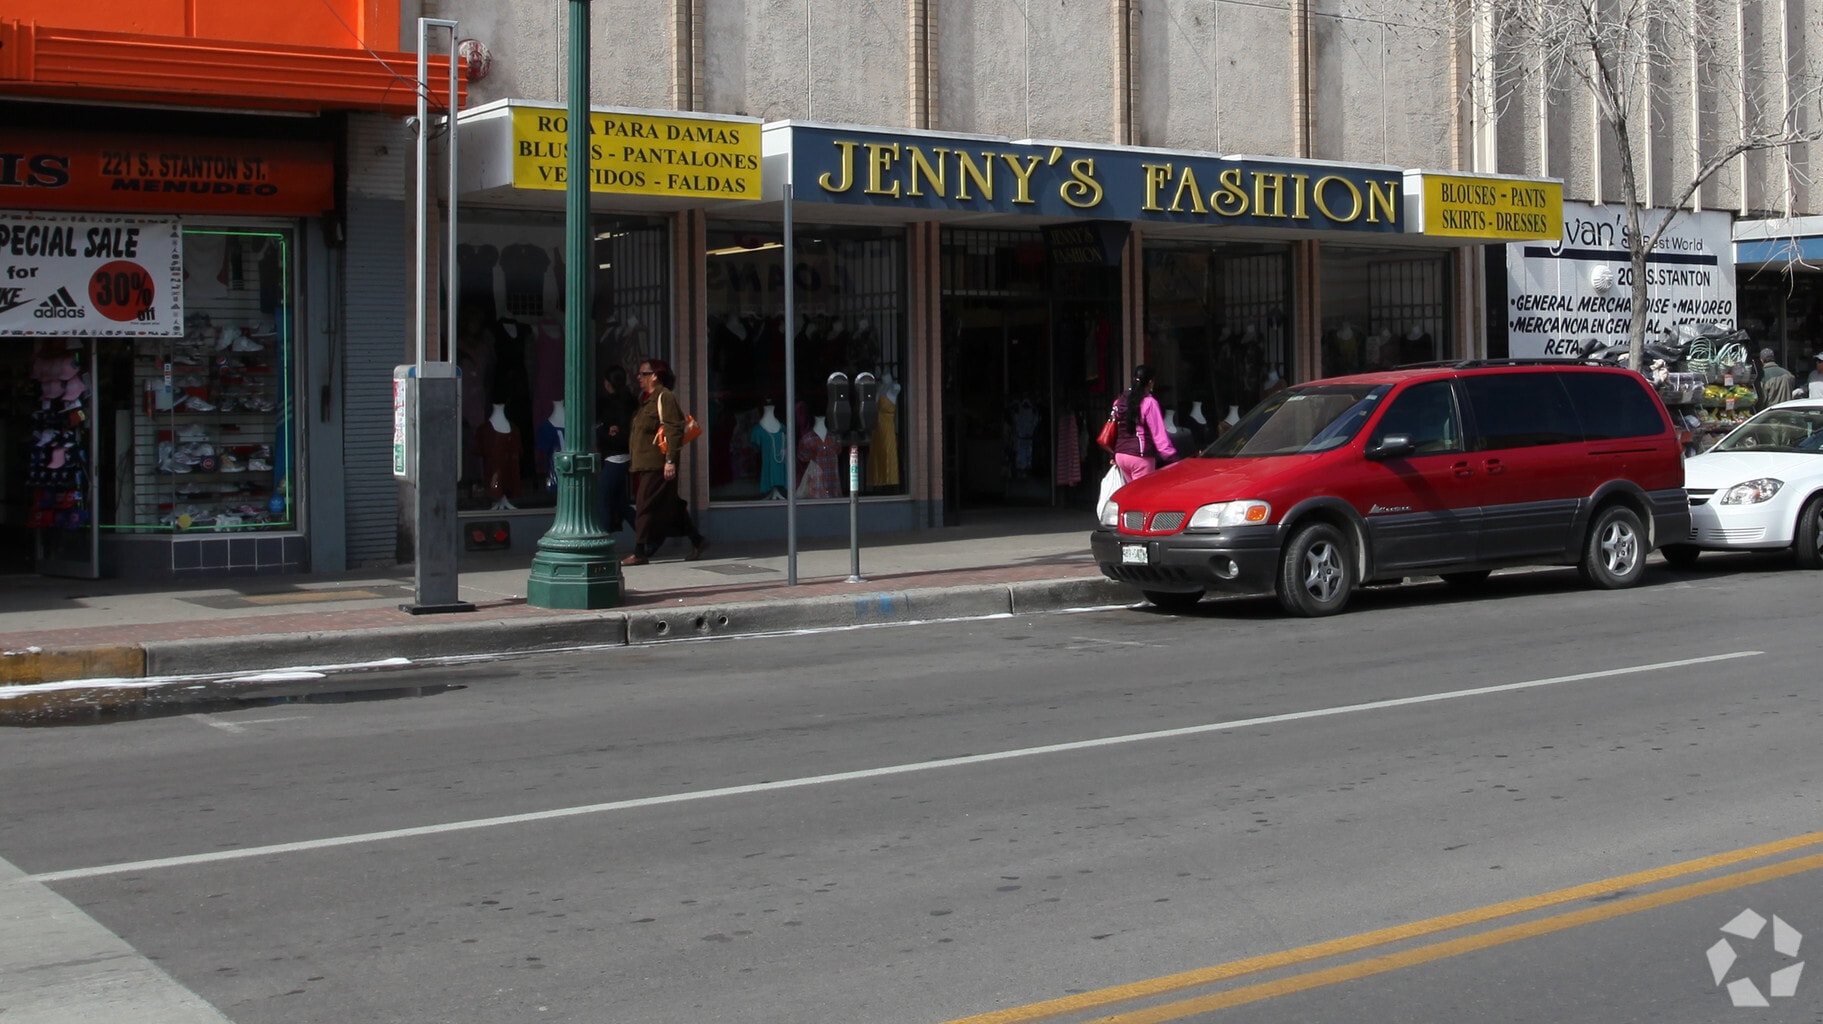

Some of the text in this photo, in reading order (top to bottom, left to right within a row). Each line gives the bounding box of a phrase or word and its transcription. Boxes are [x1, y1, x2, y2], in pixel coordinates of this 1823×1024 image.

[538, 116, 740, 145] RO PARA DAMAS
[101, 151, 267, 181] 221 S. STANTON ST.
[519, 141, 603, 161] BLUS
[622, 146, 758, 171] PANTALONES
[111, 178, 279, 196] MENUDEO
[538, 165, 646, 187] VEIDOS
[667, 173, 746, 194] FALDAS
[818, 140, 1399, 224] JENNY'S FASHION
[1441, 183, 1496, 205] BLOUSES
[1511, 187, 1546, 208] PANTS
[1442, 209, 1486, 230] SKIRTS
[1496, 212, 1547, 233] DRESSES
[84, 227, 140, 258] SALE
[1049, 226, 1095, 244] JENNY'S
[1549, 213, 1631, 254] van's
[1672, 237, 1703, 251] World
[1051, 246, 1103, 264] FASHION
[6, 265, 39, 279] for
[96, 271, 152, 307] 30%
[33, 305, 85, 318] adidas
[137, 306, 155, 321] off
[1517, 294, 1670, 314] GENERAL MERCHAISE
[1677, 298, 1732, 315] MAYOREO
[1514, 316, 1588, 334] MERCANCIA
[1590, 318, 1605, 334] EN
[1606, 318, 1661, 335] GENAL
[1544, 339, 1581, 355] RETA
